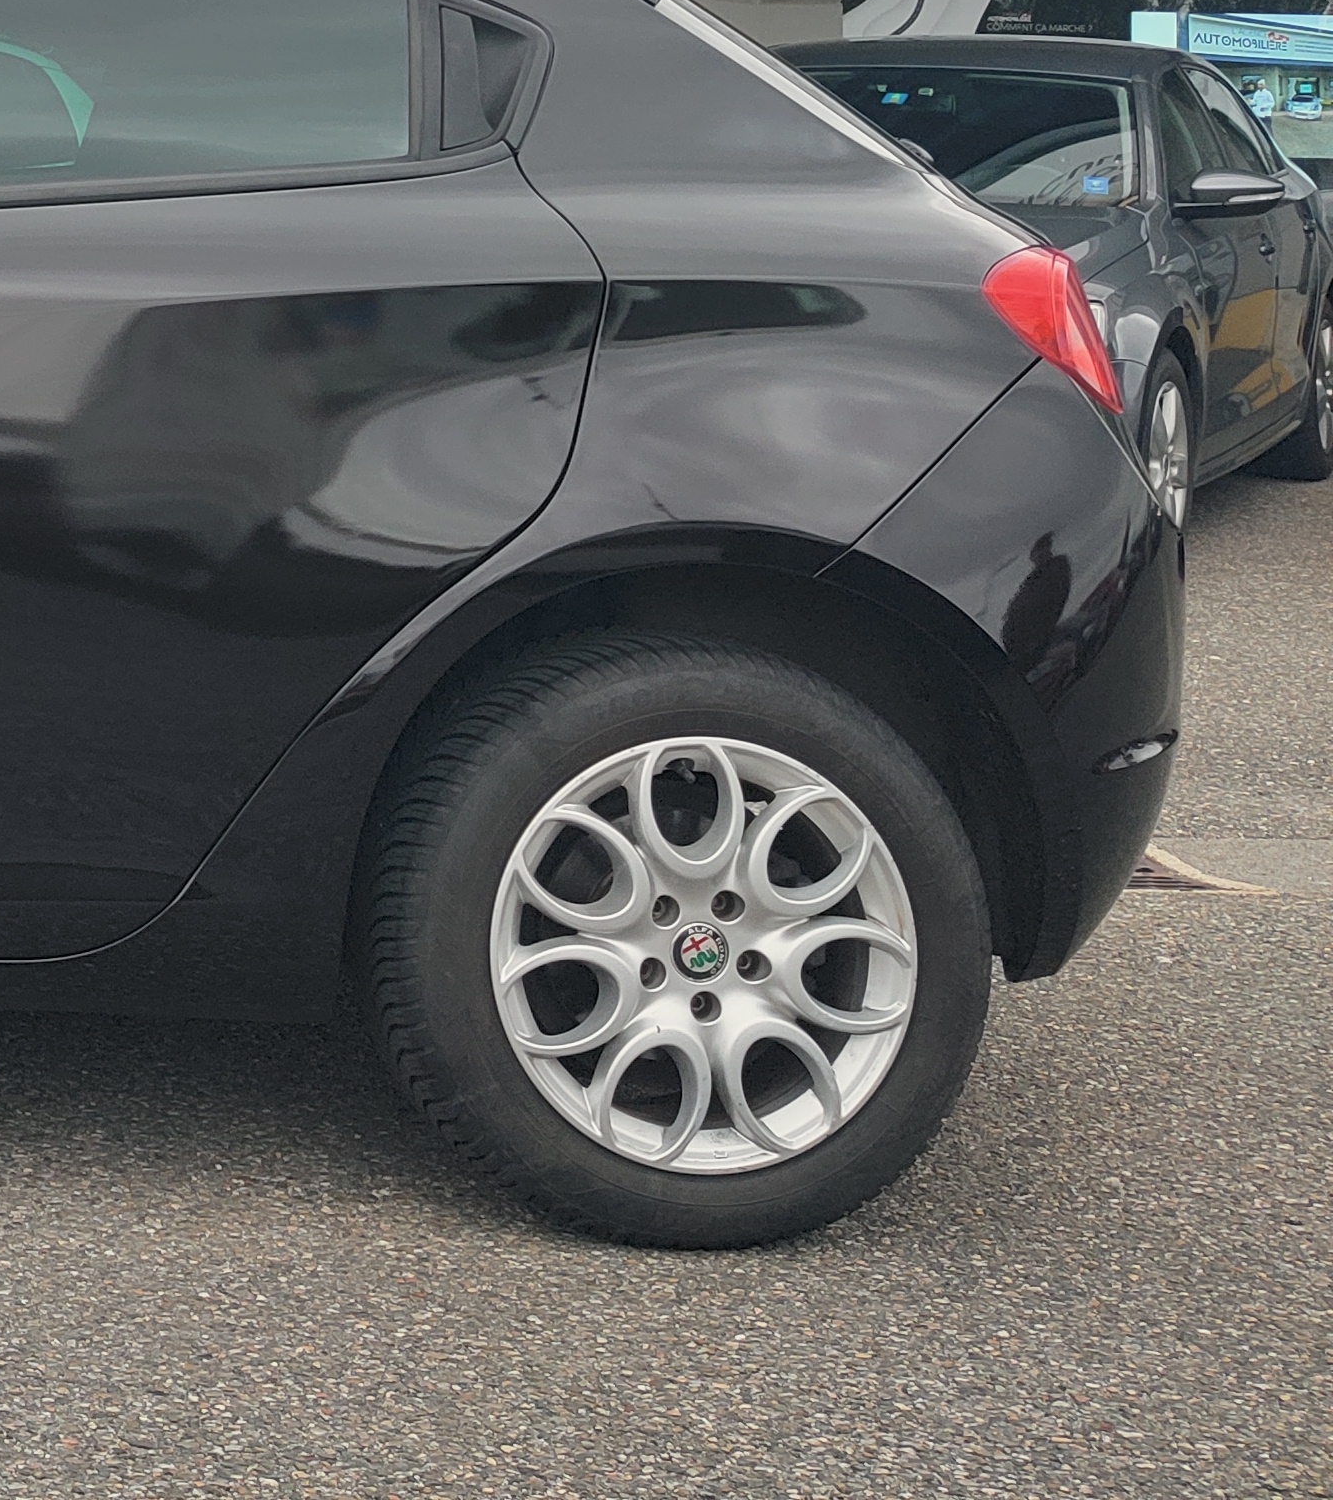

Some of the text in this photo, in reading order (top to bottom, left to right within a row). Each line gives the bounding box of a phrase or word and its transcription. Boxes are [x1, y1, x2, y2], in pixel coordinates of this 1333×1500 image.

[986, 23, 1033, 32] COMMENT
[1035, 23, 1048, 33] ÇA
[1048, 24, 1086, 33] MARCHE
[688, 926, 713, 937] ALFA
